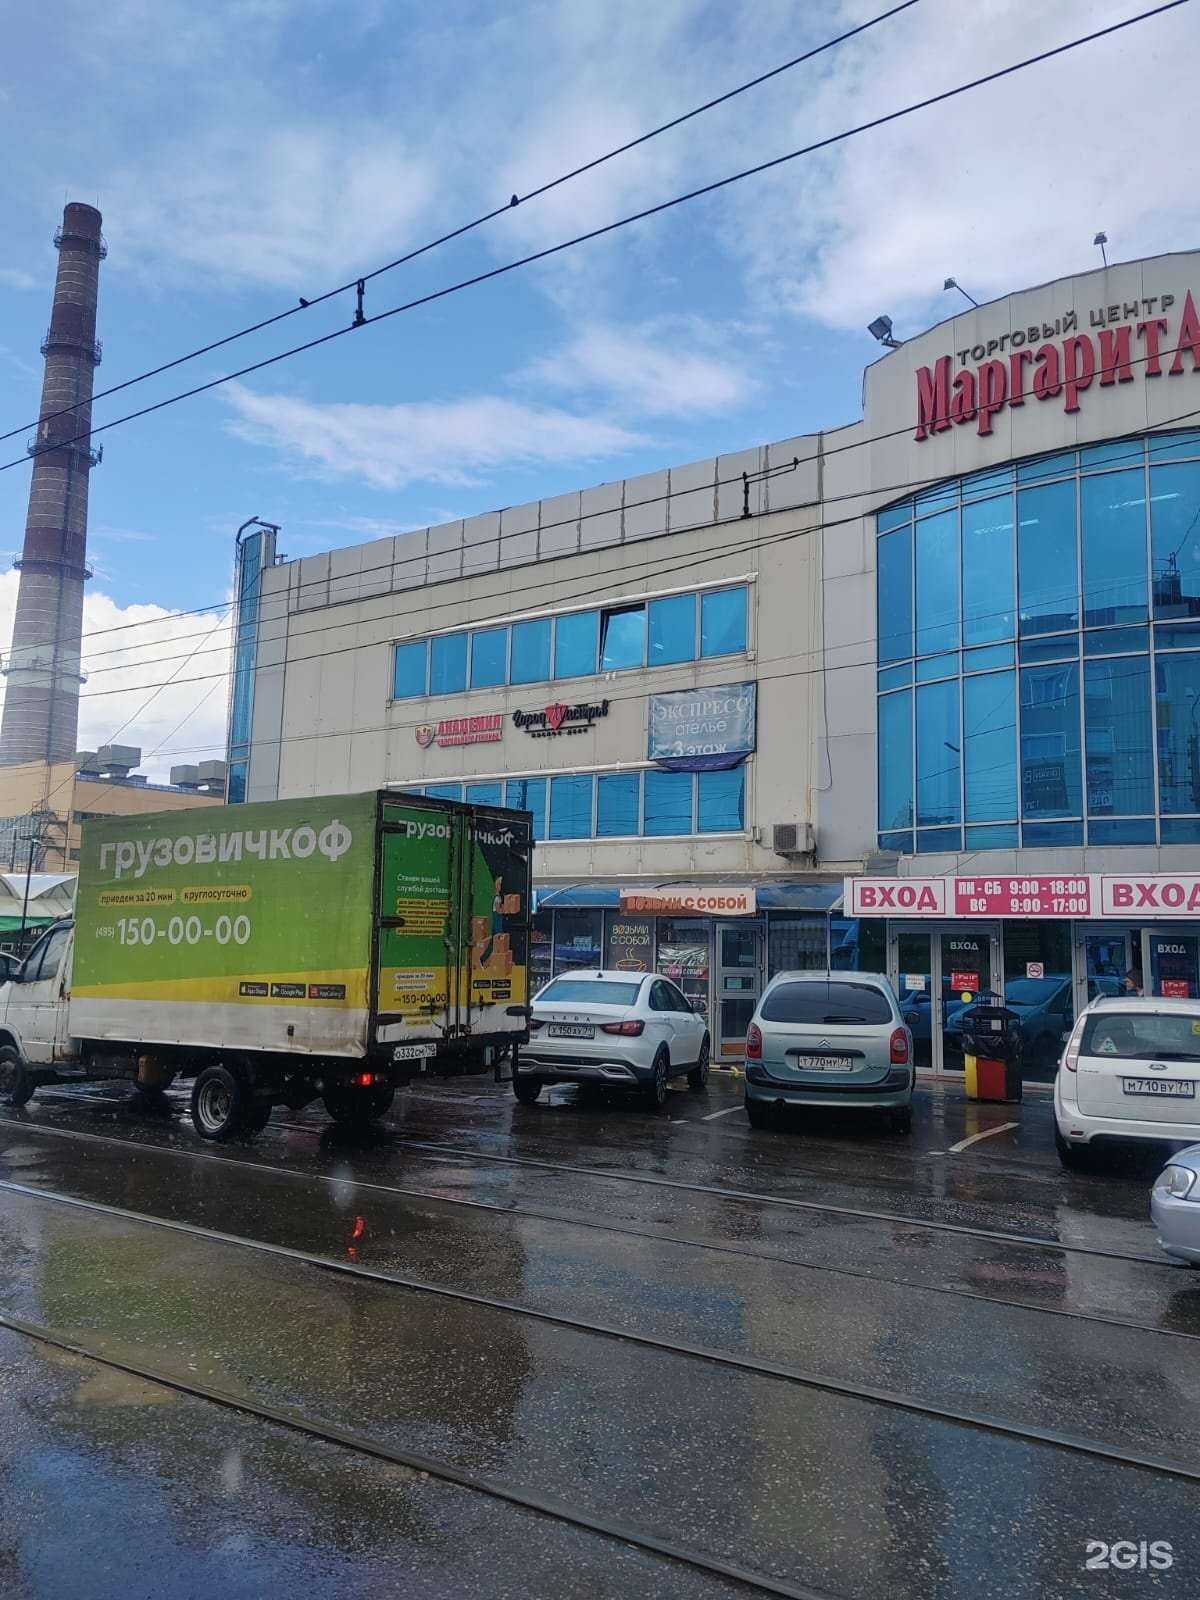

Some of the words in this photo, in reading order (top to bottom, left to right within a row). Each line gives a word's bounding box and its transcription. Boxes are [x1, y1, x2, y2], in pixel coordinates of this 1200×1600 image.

[957, 311, 1078, 365] ТОРГОВЫЙ
[1090, 294, 1175, 328] ЦЕНТР
[656, 698, 747, 720] ЭКСПРЕСС
[675, 721, 728, 736] ателье
[672, 741, 684, 756] 3
[686, 744, 727, 755] этаж
[1009, 880, 1039, 895] 9:00
[1049, 880, 1087, 895] 18:00
[146, 891, 156, 902] 20
[184, 889, 247, 902] круглосуточно
[697, 893, 747, 910] СОБОЙ
[860, 886, 938, 911] ВХОД
[970, 898, 988, 912] ВС
[1010, 898, 1041, 913] 9:00
[1051, 898, 1088, 913] 17:00
[117, 915, 251, 946] 150-00-00
[612, 924, 649, 934] ВОЗЬМИ
[619, 935, 650, 944] СОБОЙ
[950, 942, 979, 950] ВХОД
[1157, 944, 1186, 953] ВХОД
